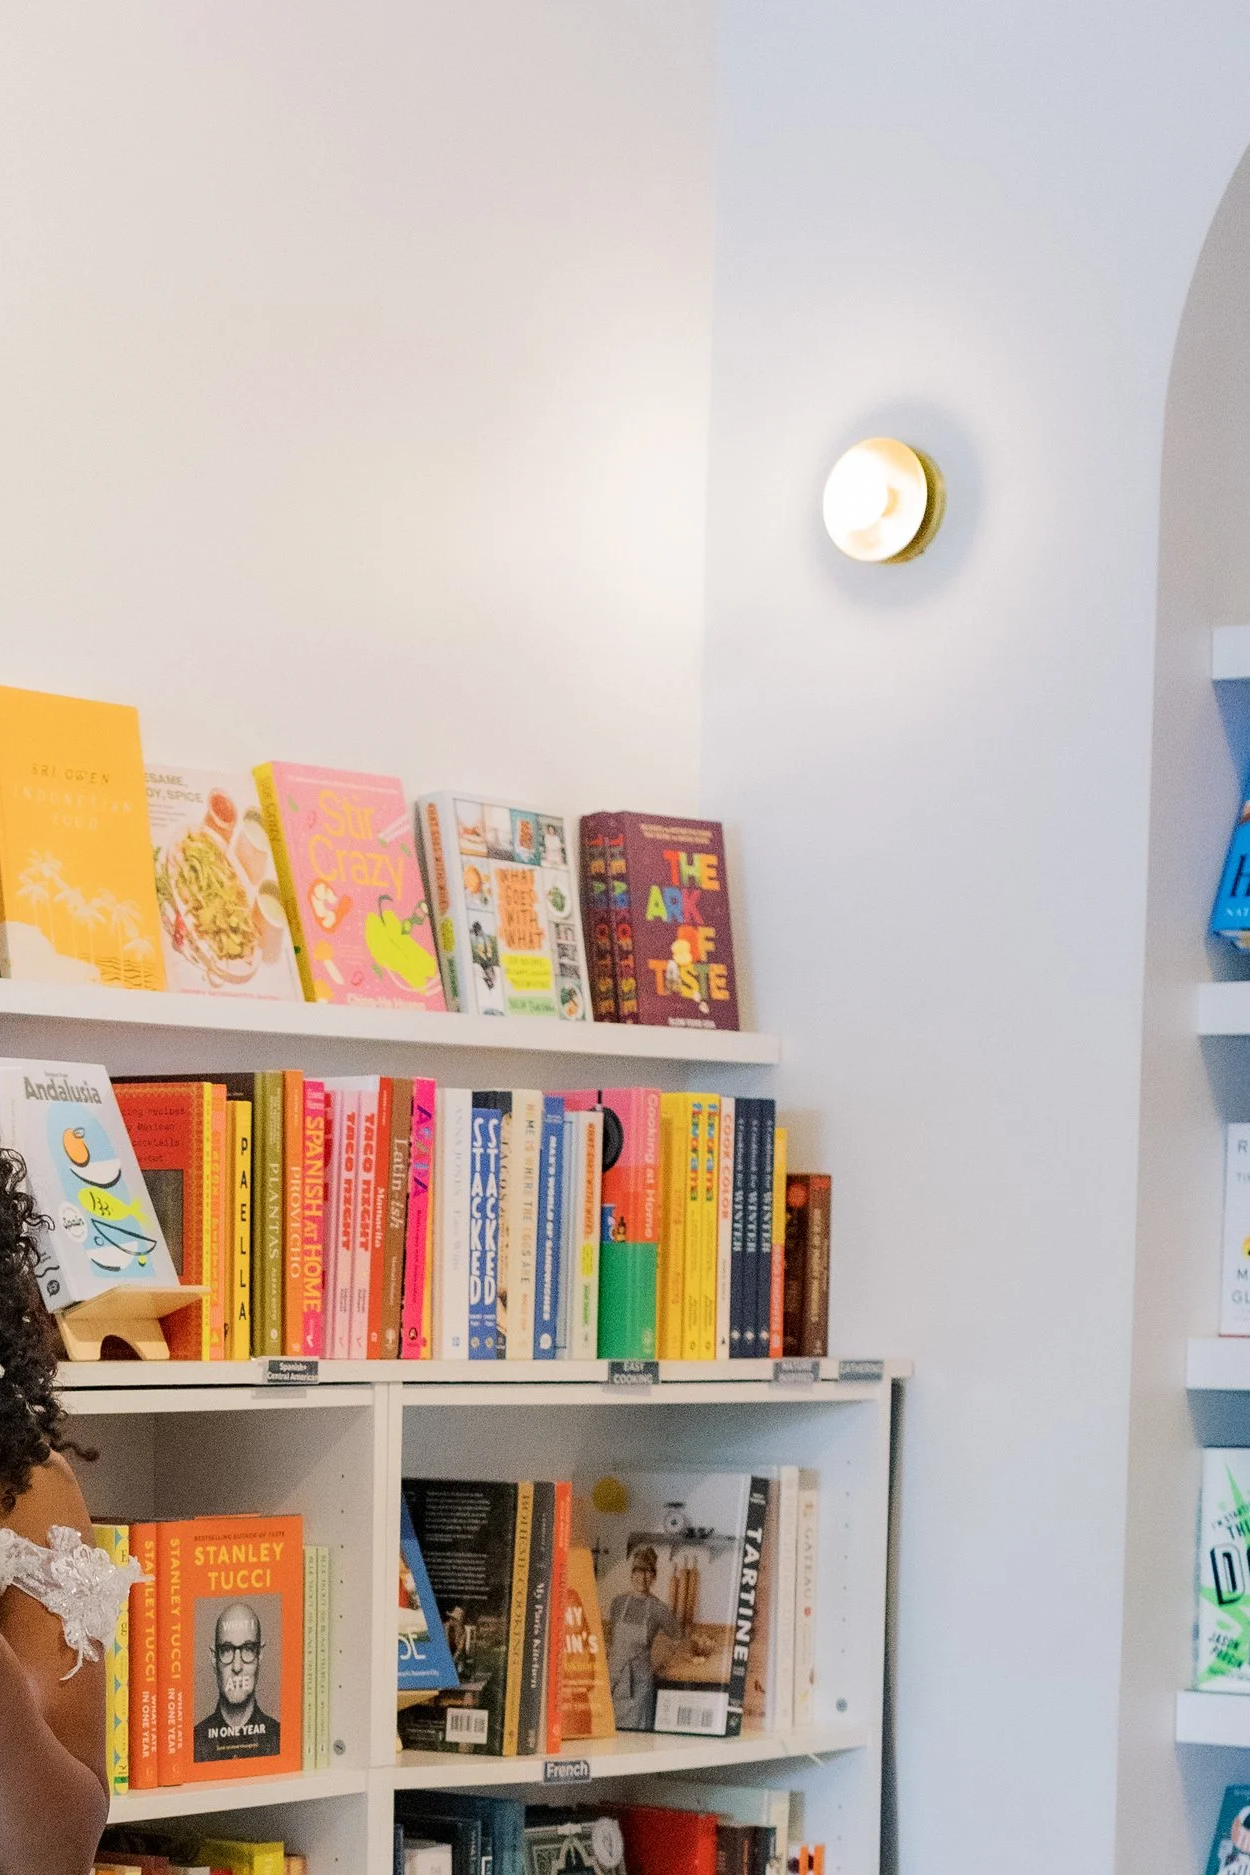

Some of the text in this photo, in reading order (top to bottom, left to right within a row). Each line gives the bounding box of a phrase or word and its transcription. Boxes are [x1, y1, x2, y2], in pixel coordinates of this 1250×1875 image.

[661, 848, 721, 891] THE
[645, 884, 704, 925] ARK
[268, 1163, 281, 1259] PLANTAS
[303, 1115, 323, 1313] SPANISH AT HOME
[193, 1542, 285, 1567] STANLEY
[208, 1568, 271, 1591] TUCCI
[734, 1526, 764, 1664] TARTINE
[170, 1538, 182, 1680] STANLEY TUCCI
[208, 1724, 267, 1739] IN ONE YEAR
[545, 1760, 589, 1777] French
